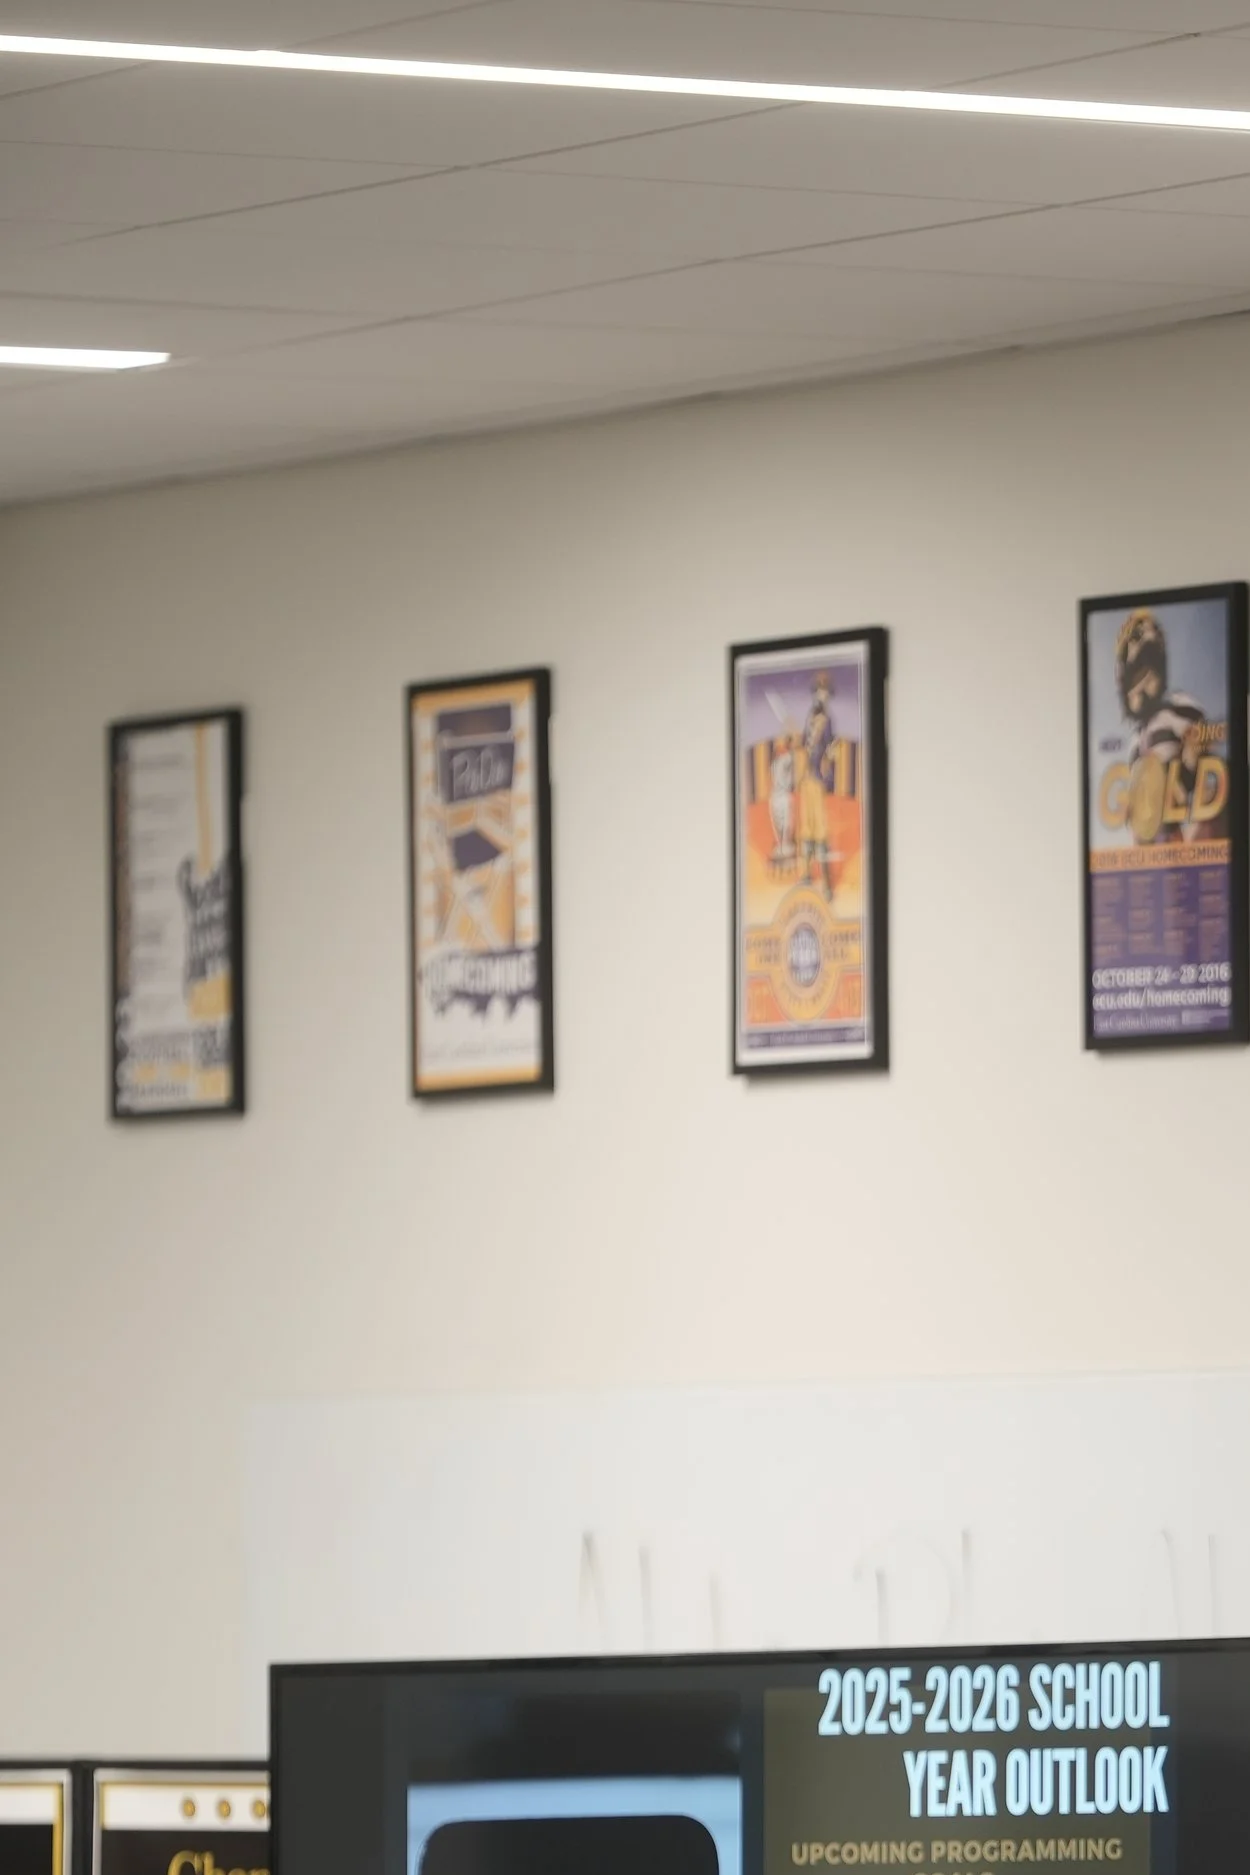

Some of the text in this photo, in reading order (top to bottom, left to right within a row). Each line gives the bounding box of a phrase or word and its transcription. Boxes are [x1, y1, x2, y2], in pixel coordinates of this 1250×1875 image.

[818, 1661, 1170, 1736] 2025-2026 SCHOOL
[903, 1746, 1170, 1818] YEAR OUTLOOK
[791, 1838, 1122, 1866] UPCOMING PROGRAMMING
